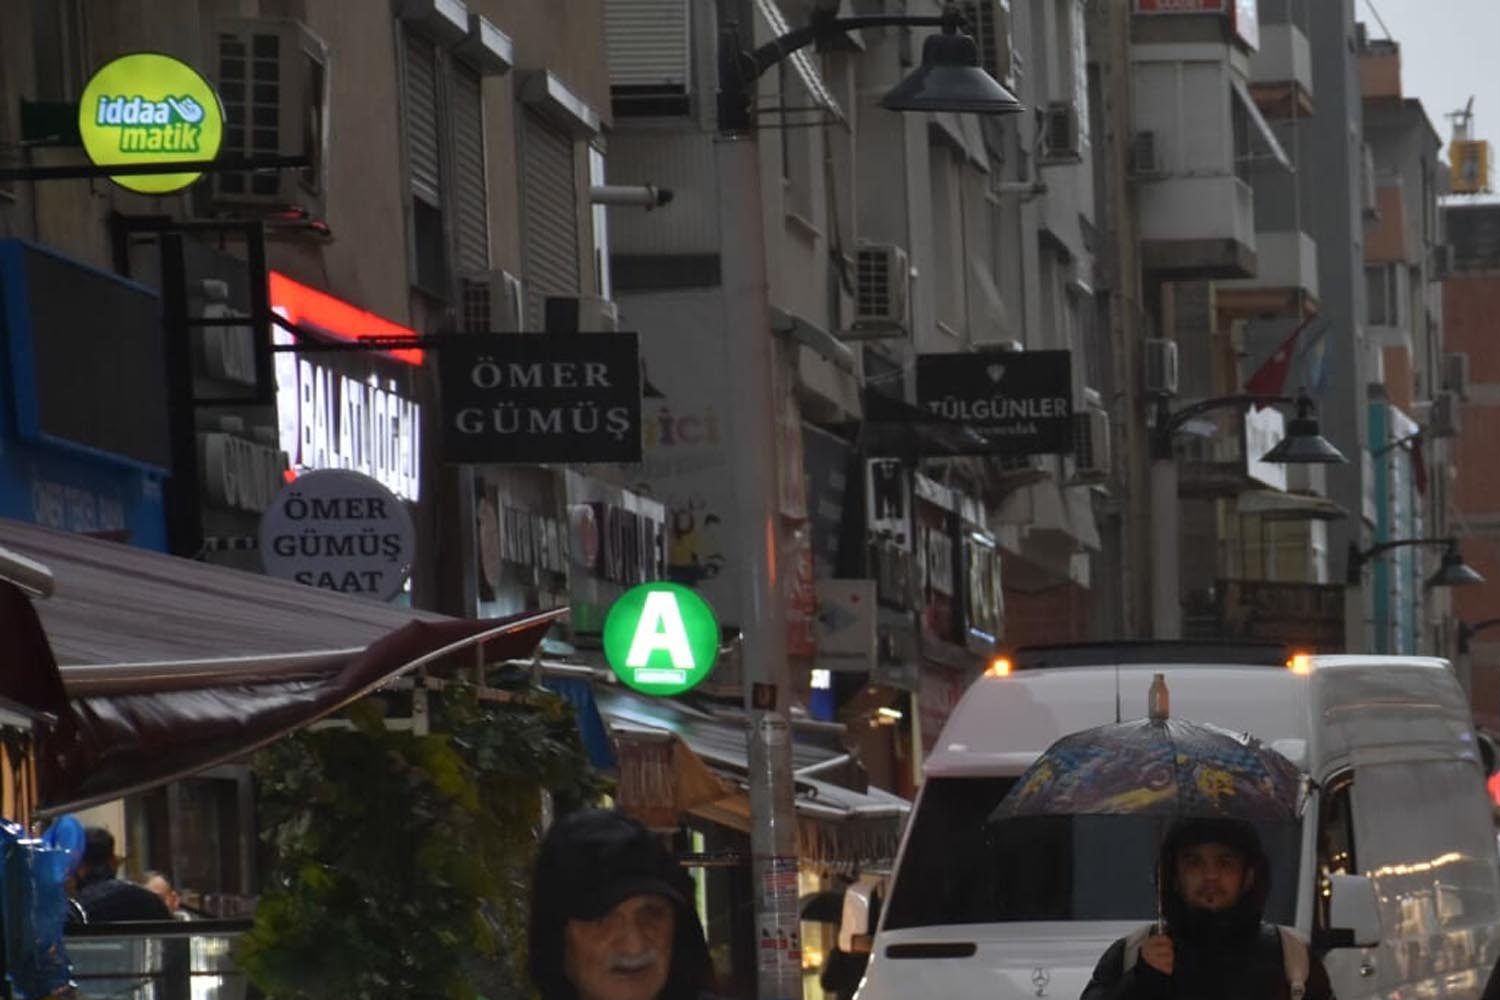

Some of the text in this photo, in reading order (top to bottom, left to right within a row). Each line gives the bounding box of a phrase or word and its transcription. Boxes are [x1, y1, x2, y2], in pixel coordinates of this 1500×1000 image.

[98, 96, 170, 124] iddaa
[121, 123, 197, 150] matik
[471, 356, 613, 389] ÖMER
[455, 401, 631, 441] GÜMÜŞ
[928, 395, 1067, 420] TÜLGÜNLER
[284, 492, 388, 521] ÖMER
[272, 528, 402, 562] GÜMÜŞ
[294, 570, 384, 593] SAAT
[625, 591, 695, 669] A
